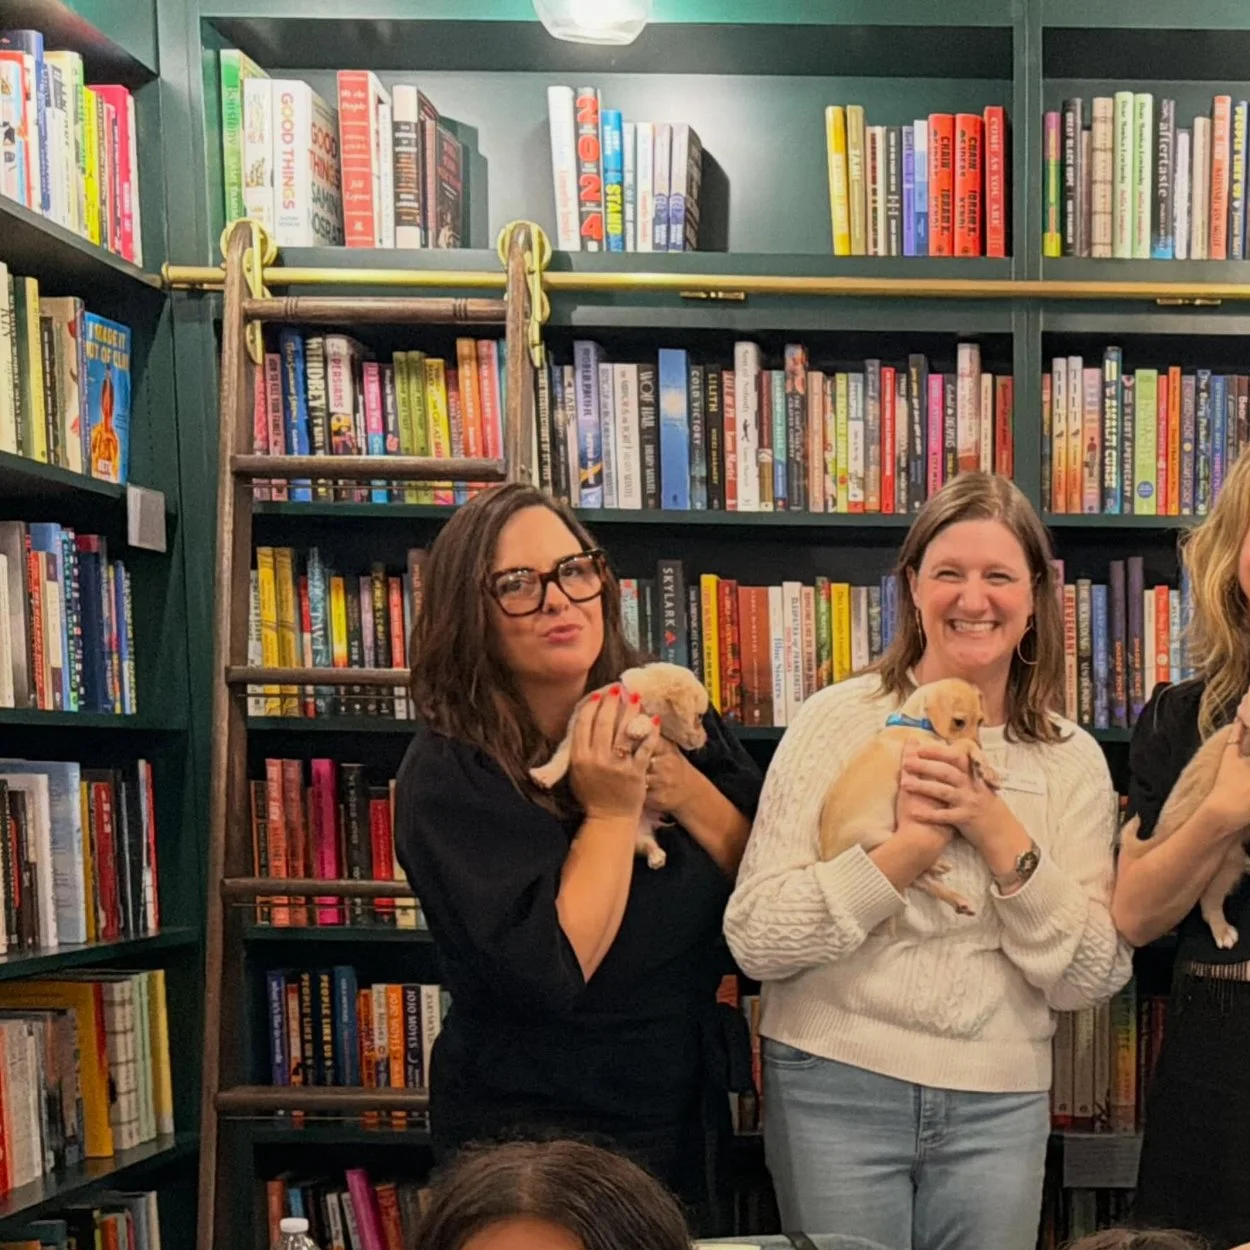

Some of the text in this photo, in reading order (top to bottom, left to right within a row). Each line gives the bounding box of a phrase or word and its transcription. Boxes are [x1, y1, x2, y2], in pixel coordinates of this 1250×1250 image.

[281, 92, 294, 209] GOOD THINGS
[1158, 122, 1171, 198] aftertaste
[606, 184, 622, 235] STAND
[306, 337, 326, 408] WHIDBEY
[331, 359, 344, 409] PERSIANS
[640, 371, 655, 404] WOLF
[708, 373, 718, 412] LILITH
[641, 407, 655, 429] HALL
[691, 370, 702, 445] COLD VICTORY
[1123, 415, 1131, 439] LOST
[1238, 396, 1247, 419] Bear
[1104, 398, 1117, 488] AMALFI CURSE
[661, 567, 676, 627] SKYLARK
[1065, 596, 1075, 655] REVENANT
[774, 637, 784, 698] Blue Sisters
[271, 980, 280, 1001] what
[301, 973, 311, 1014] PEOPLE
[320, 975, 332, 1057] PEOPLE LIKE US
[406, 989, 417, 1048] JOJO MOYES
[303, 1017, 312, 1040] LIKE
[390, 992, 401, 1050] JOJO MOYES
